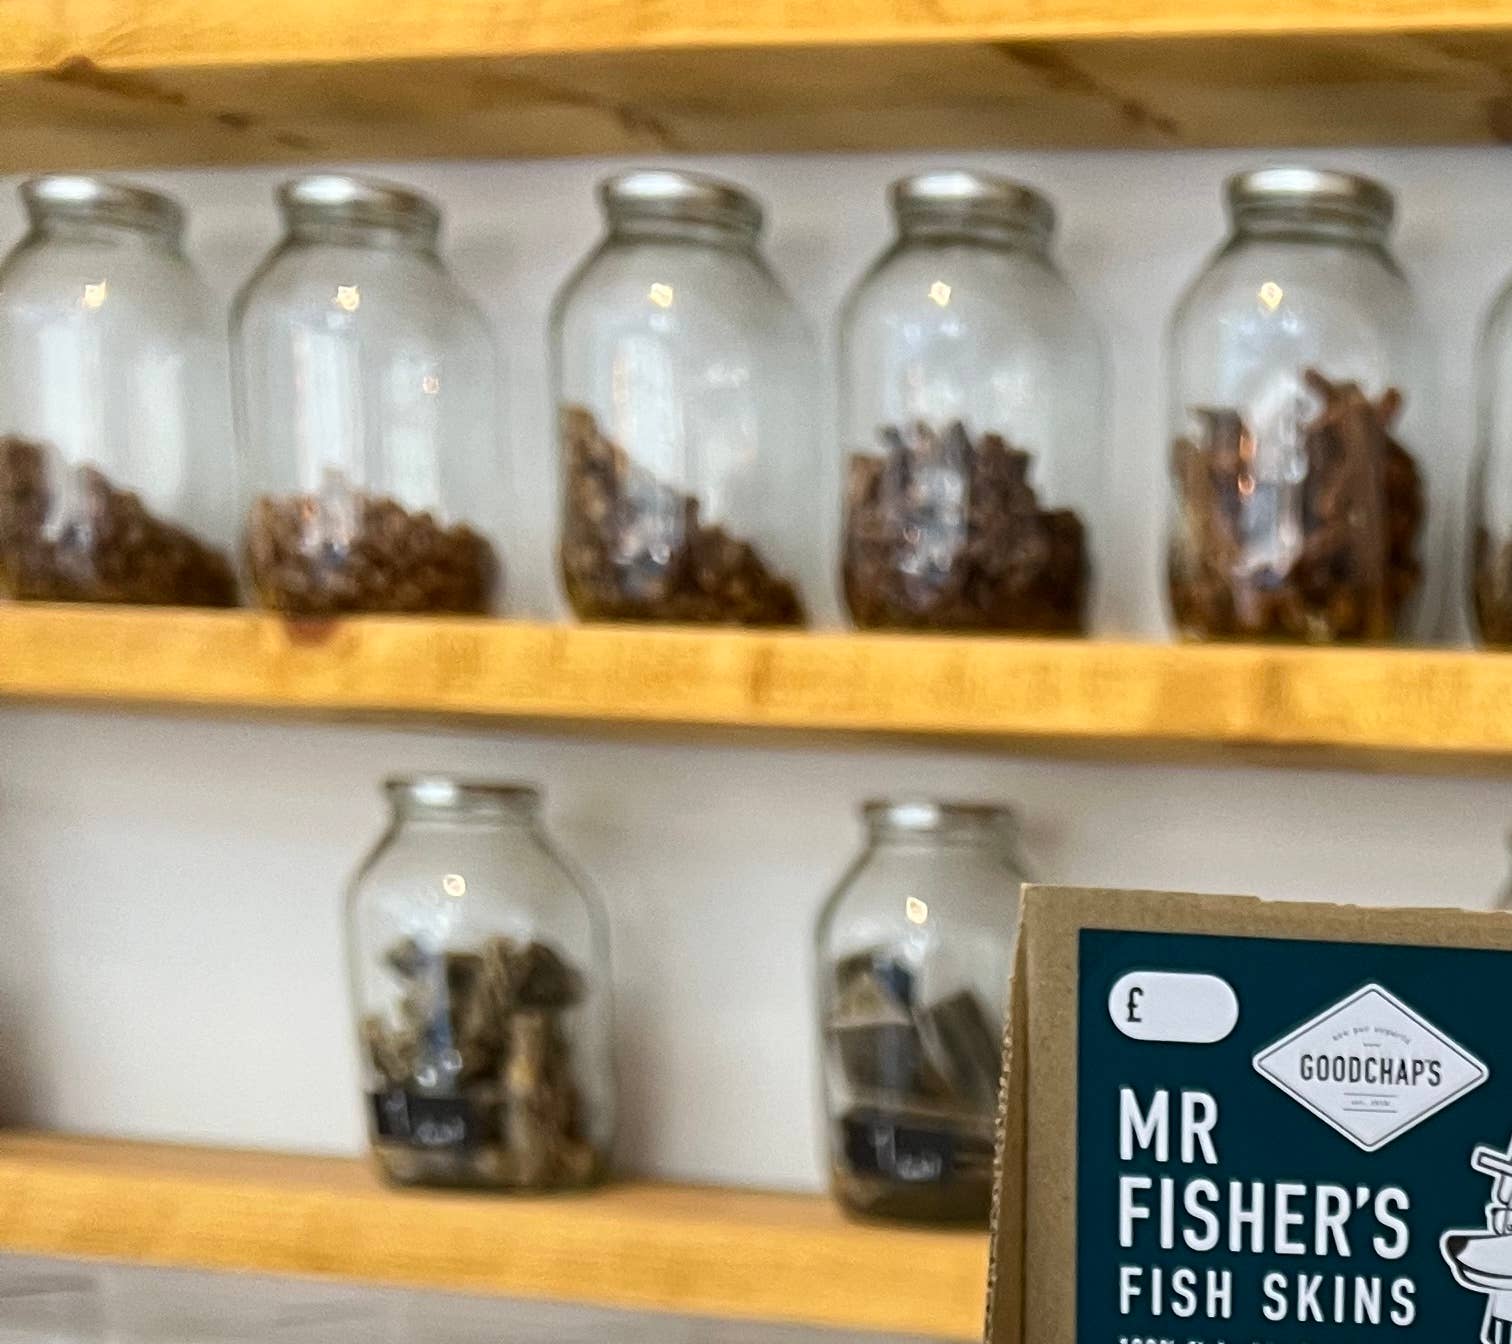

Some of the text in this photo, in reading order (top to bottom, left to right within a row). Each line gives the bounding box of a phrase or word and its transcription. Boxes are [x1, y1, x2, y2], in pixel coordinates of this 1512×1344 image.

[1119, 1087, 1219, 1166] MR
[1119, 1176, 1411, 1260] FISHER'S
[1119, 1266, 1417, 1326] FISH SKINS
